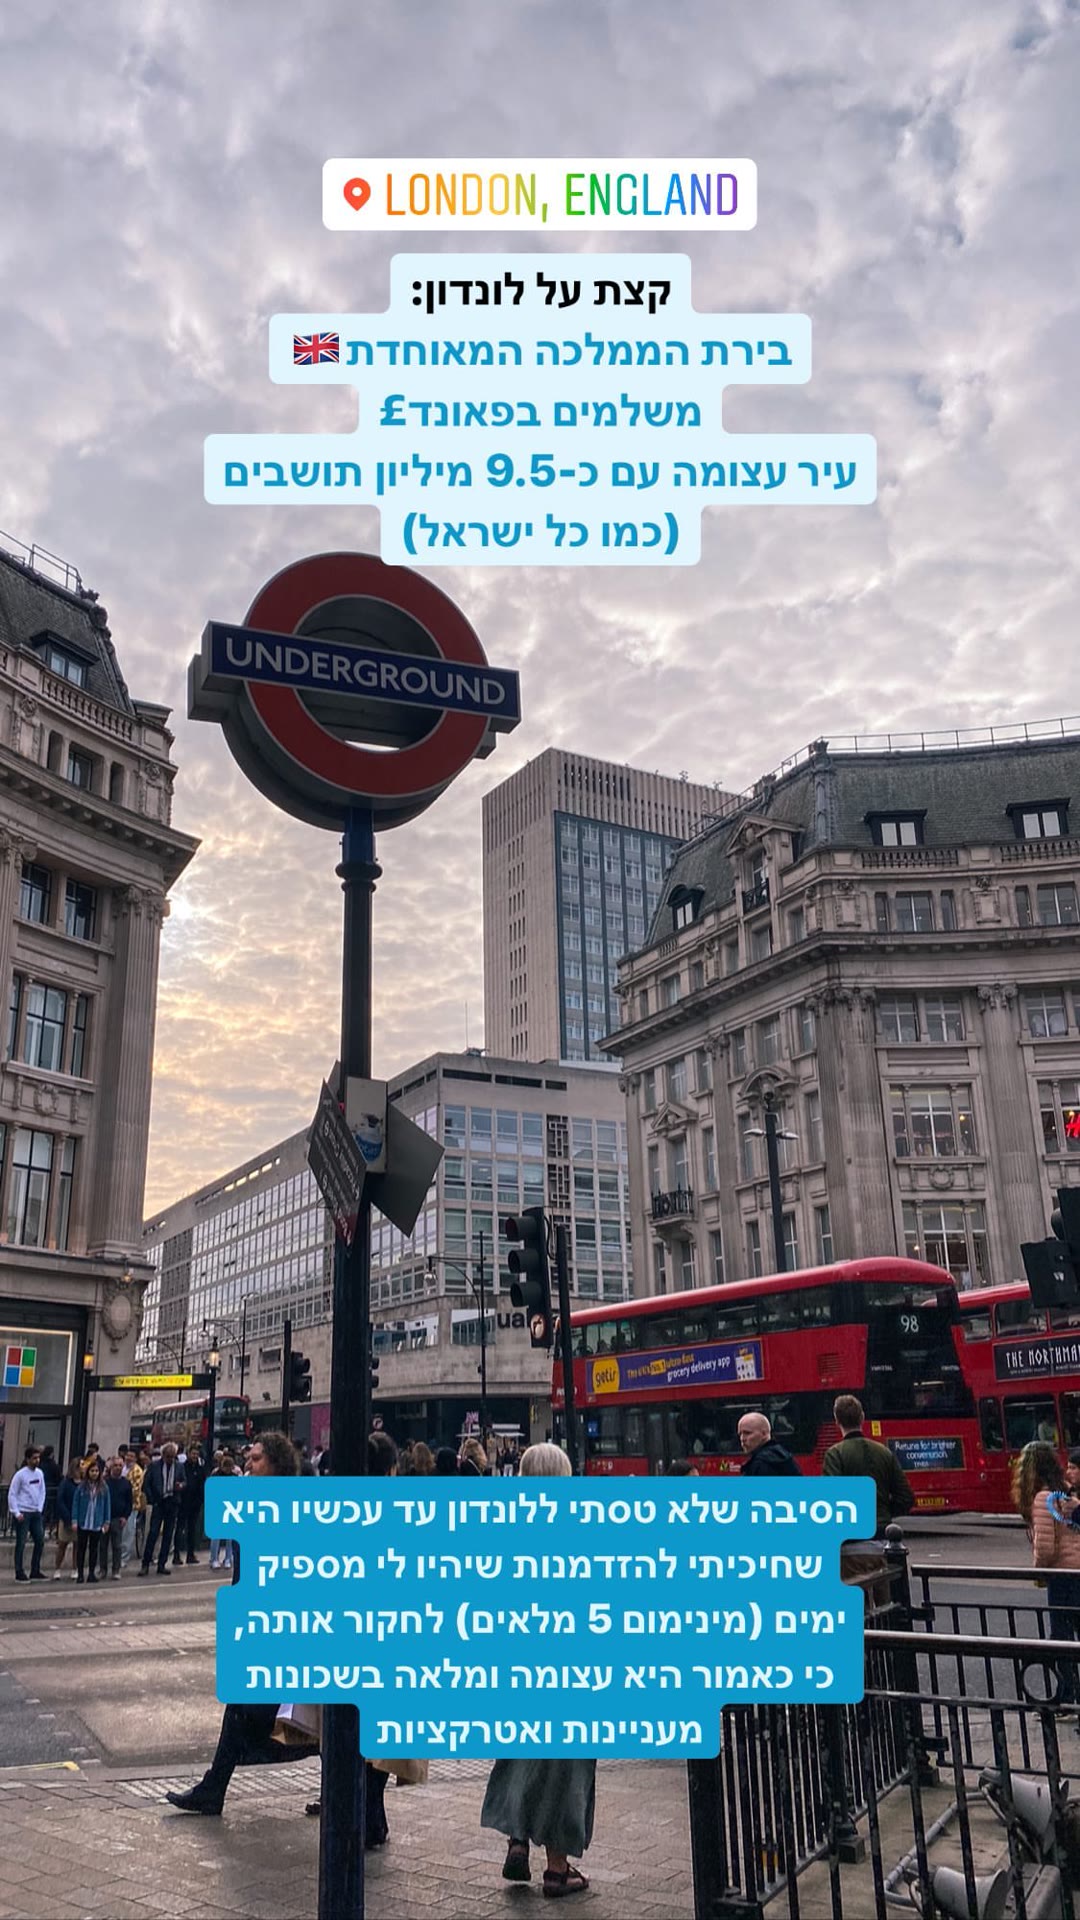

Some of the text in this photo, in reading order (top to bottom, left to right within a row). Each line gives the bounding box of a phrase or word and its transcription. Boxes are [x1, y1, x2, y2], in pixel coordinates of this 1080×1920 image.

[225, 636, 506, 706] UNDERGROUND
[900, 1314, 920, 1333] 98
[1006, 1344, 1080, 1368] THE NORTHMA
[595, 1370, 616, 1387] getir
[667, 1356, 731, 1382] grocery delivery app
[931, 1440, 957, 1450] brighter
